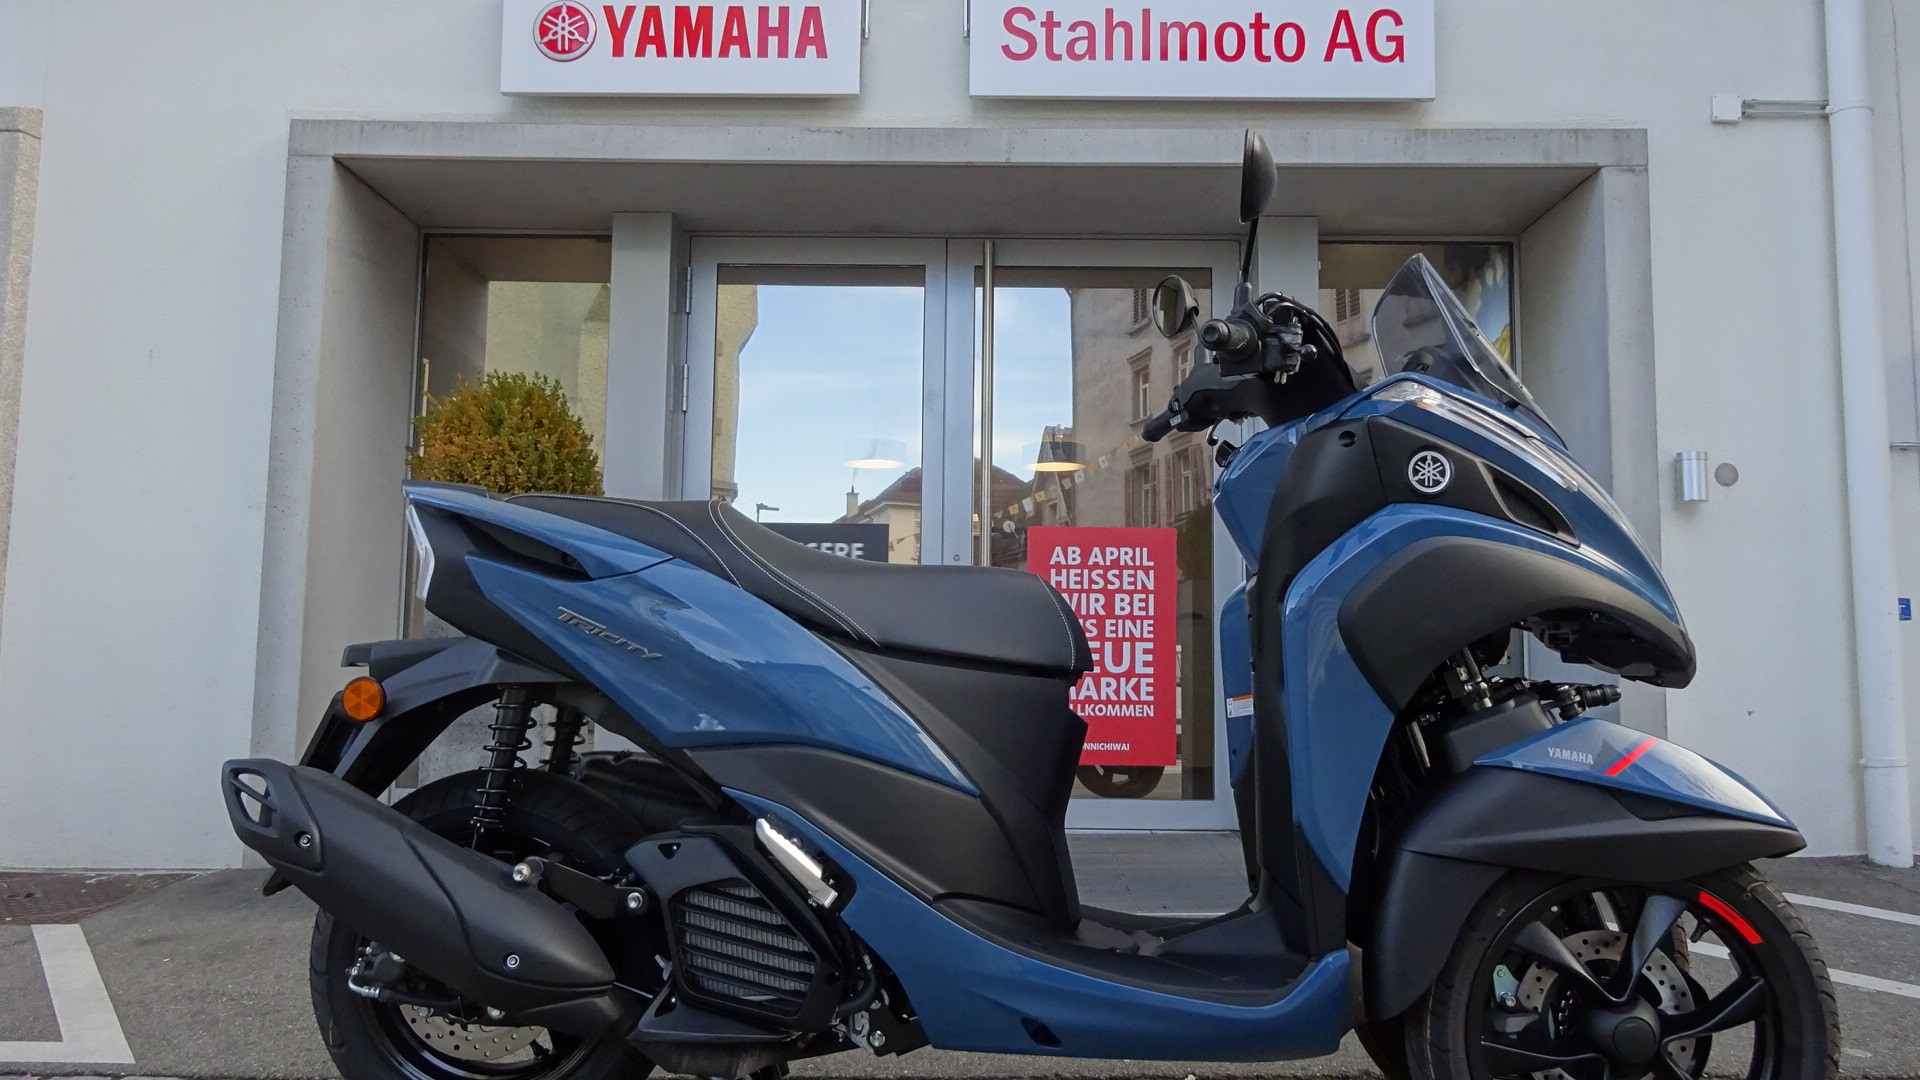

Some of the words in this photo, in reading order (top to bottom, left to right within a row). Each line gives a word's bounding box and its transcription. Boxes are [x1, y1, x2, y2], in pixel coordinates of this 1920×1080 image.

[602, 5, 828, 59] YAMAHA
[1000, 6, 1306, 62] Stahlmoto
[1323, 9, 1405, 63] AG
[1049, 546, 1081, 565] AB
[1087, 547, 1154, 566] APRIL
[1050, 568, 1154, 590] HEISSEN
[1114, 593, 1154, 616] BEI
[1105, 619, 1154, 638] EINE
[1547, 747, 1595, 764] YAMAHA
